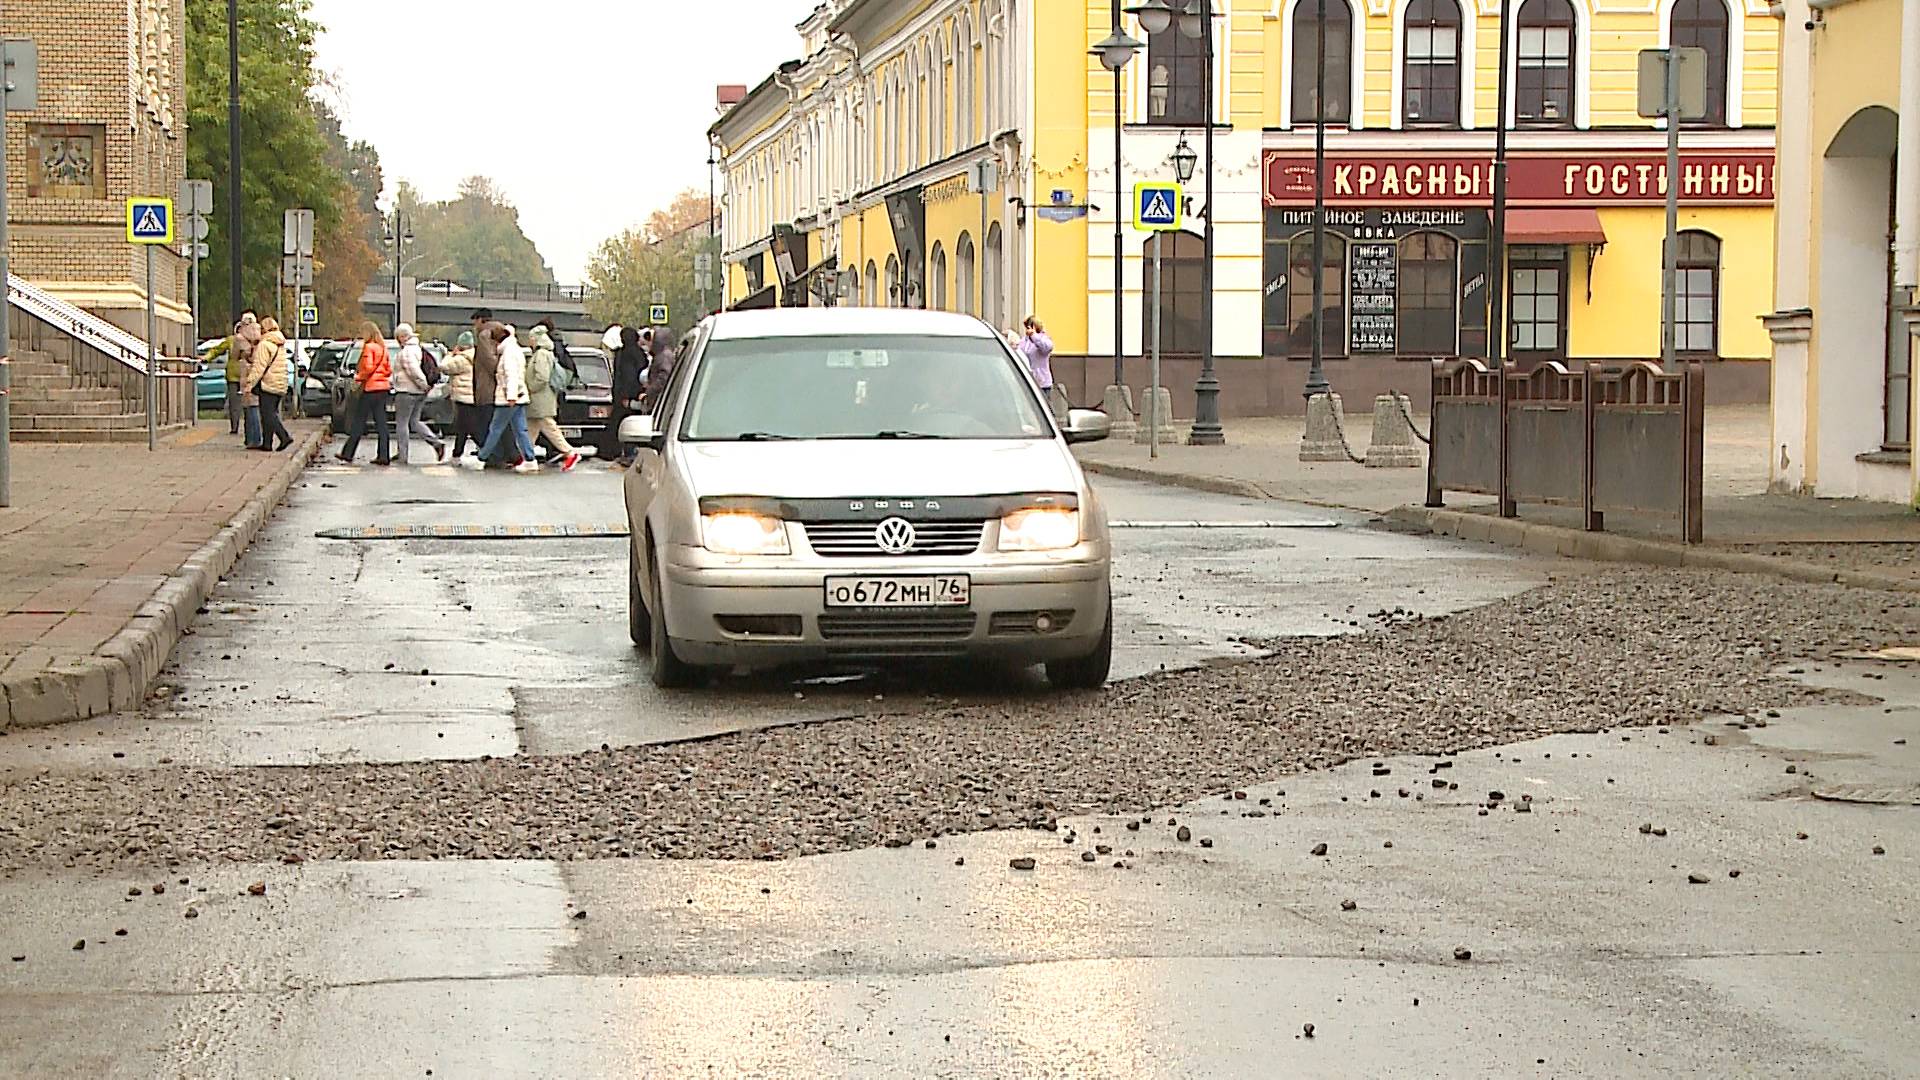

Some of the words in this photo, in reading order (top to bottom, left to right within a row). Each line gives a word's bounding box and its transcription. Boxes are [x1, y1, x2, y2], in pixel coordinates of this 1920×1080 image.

[1564, 164, 1775, 195] ГОСТИННЫ
[1283, 210, 1365, 225] ПИТЙНОЕ
[1353, 226, 1396, 239] ЯВКА
[937, 578, 960, 596] 76
